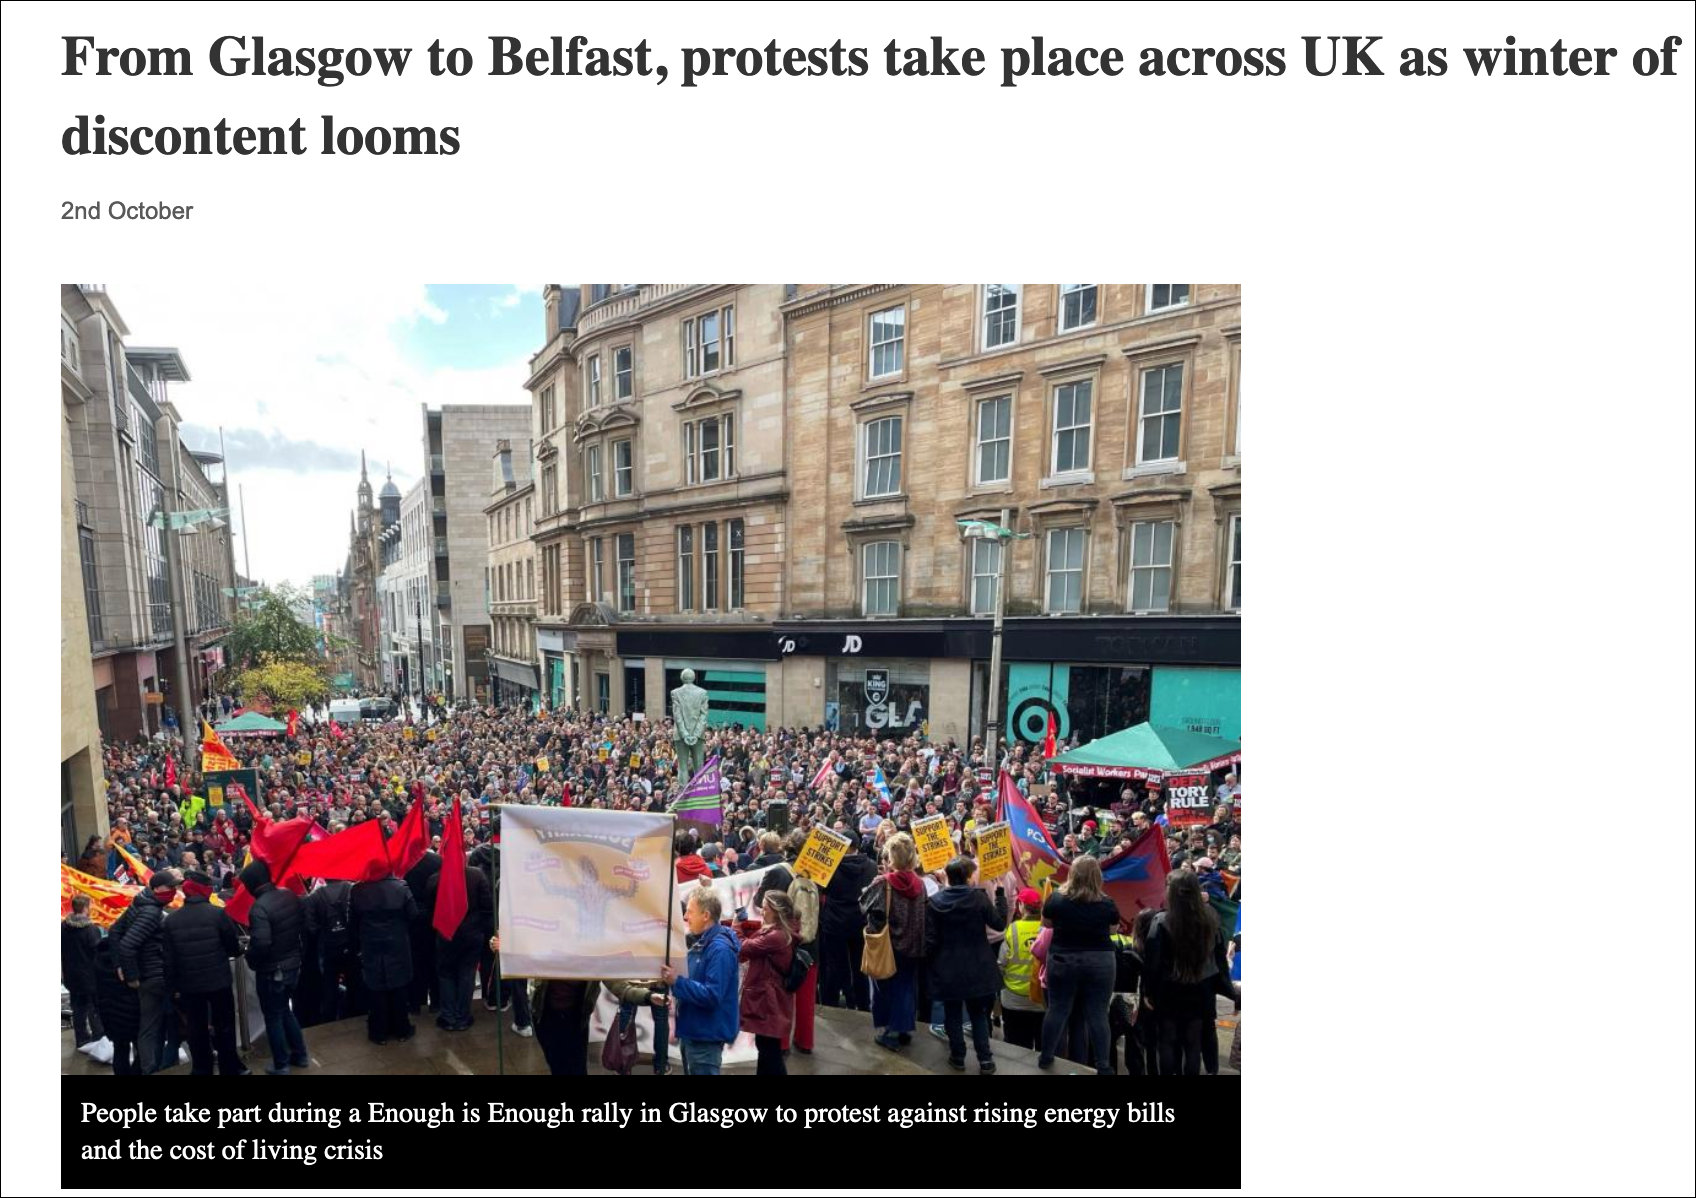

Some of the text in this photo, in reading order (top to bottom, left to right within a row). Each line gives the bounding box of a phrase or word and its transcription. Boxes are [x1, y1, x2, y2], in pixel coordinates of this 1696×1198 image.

[782, 640, 796, 653] JD
[842, 635, 862, 653] JD
[868, 680, 886, 688] KING
[1062, 765, 1095, 776] Socialist
[1097, 767, 1131, 779] Workers
[1169, 775, 1207, 787] DEFY
[1169, 785, 1208, 798] TORY
[1170, 797, 1210, 808] RULE
[915, 821, 944, 836] SUPPORT
[813, 831, 845, 850] SUPPORT
[926, 831, 939, 841] THE
[980, 828, 1007, 845] SUPPORT
[819, 843, 831, 855] THE
[921, 840, 948, 853] STRIKES
[988, 840, 998, 850] THE
[806, 848, 835, 867] STRIKES
[982, 847, 1007, 863] STRIKES
